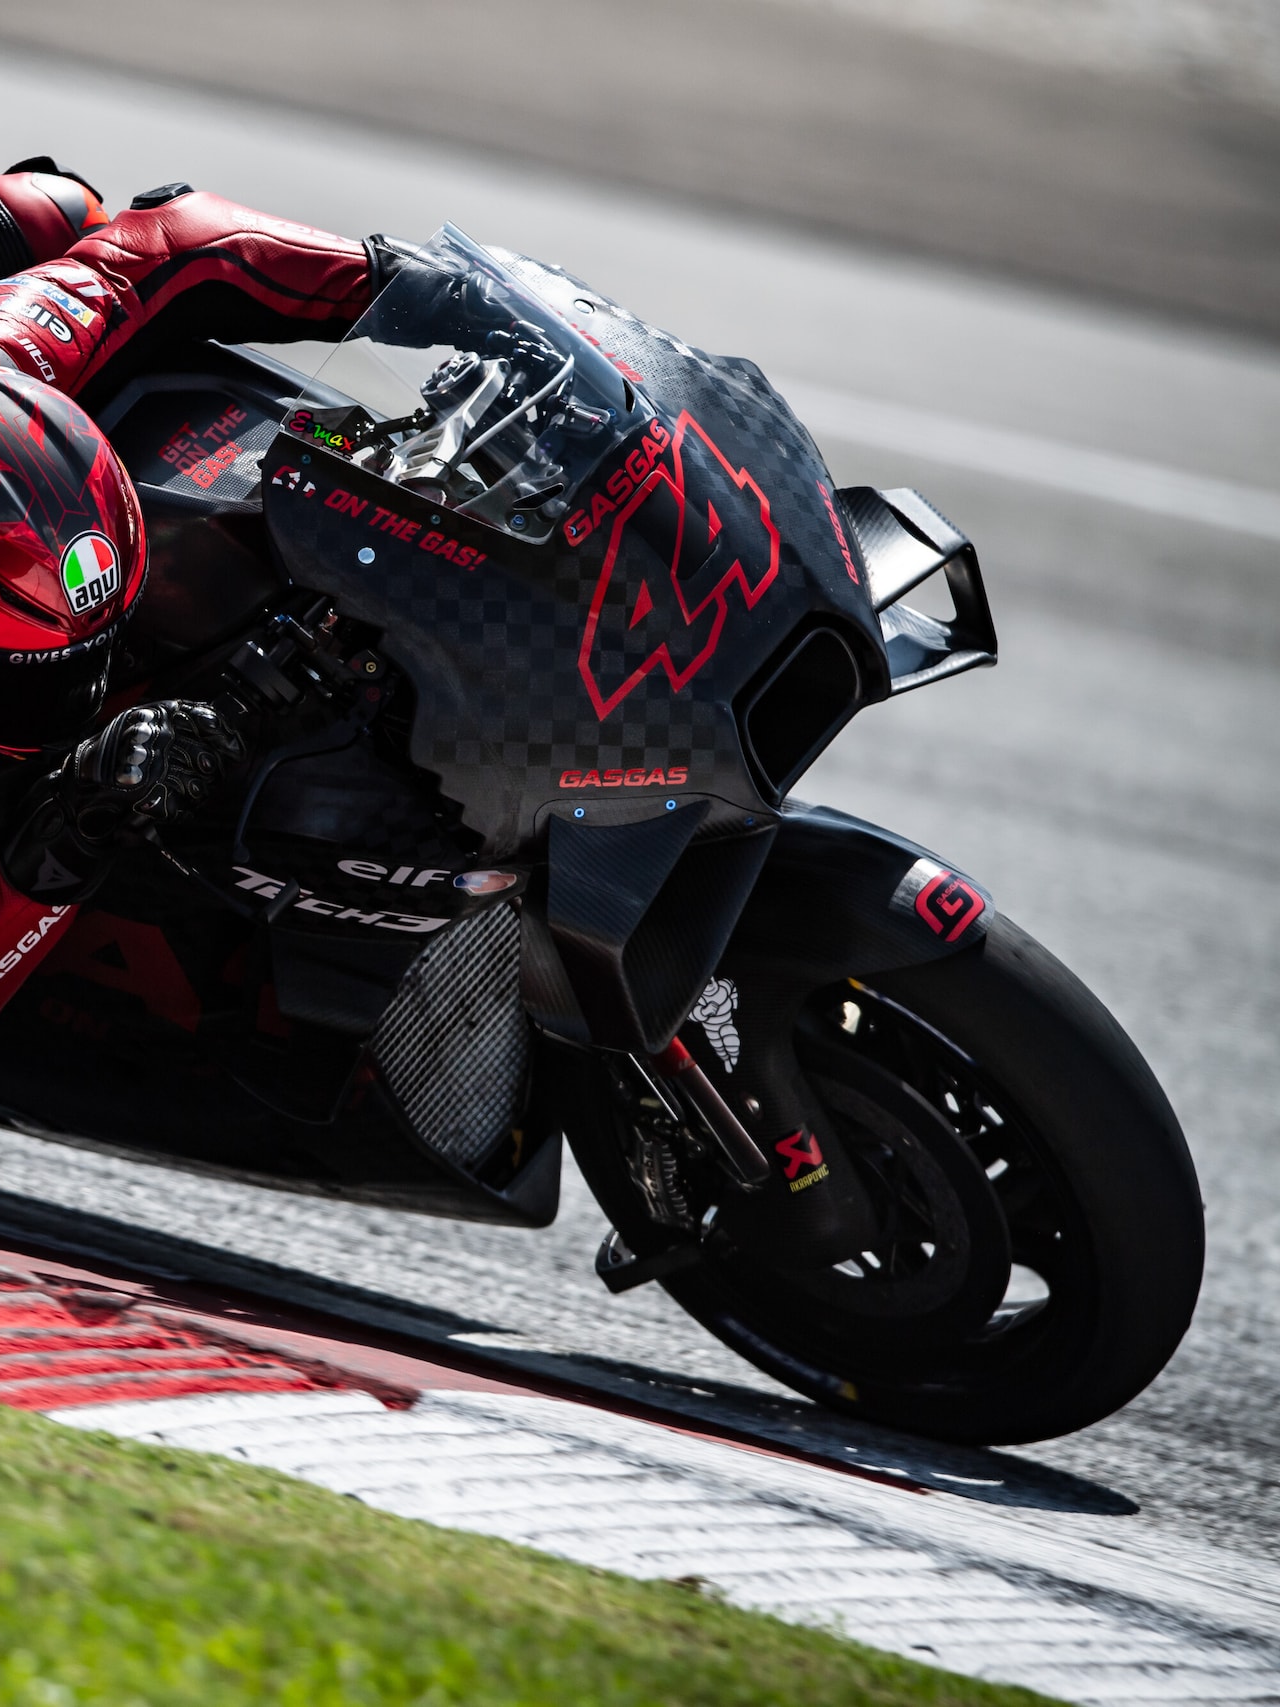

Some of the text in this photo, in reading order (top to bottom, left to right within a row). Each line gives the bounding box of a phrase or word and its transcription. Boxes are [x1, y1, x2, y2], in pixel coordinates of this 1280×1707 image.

[159, 422, 198, 463] GET
[176, 402, 248, 476] ON THE
[190, 440, 242, 489] GAS!
[563, 418, 671, 547] GASGAS
[324, 489, 487, 571] ON THE GAS!
[75, 567, 114, 609] agv
[9, 623, 118, 665] GIVES YOU
[559, 766, 688, 788] GASGAS
[337, 859, 452, 887] elf
